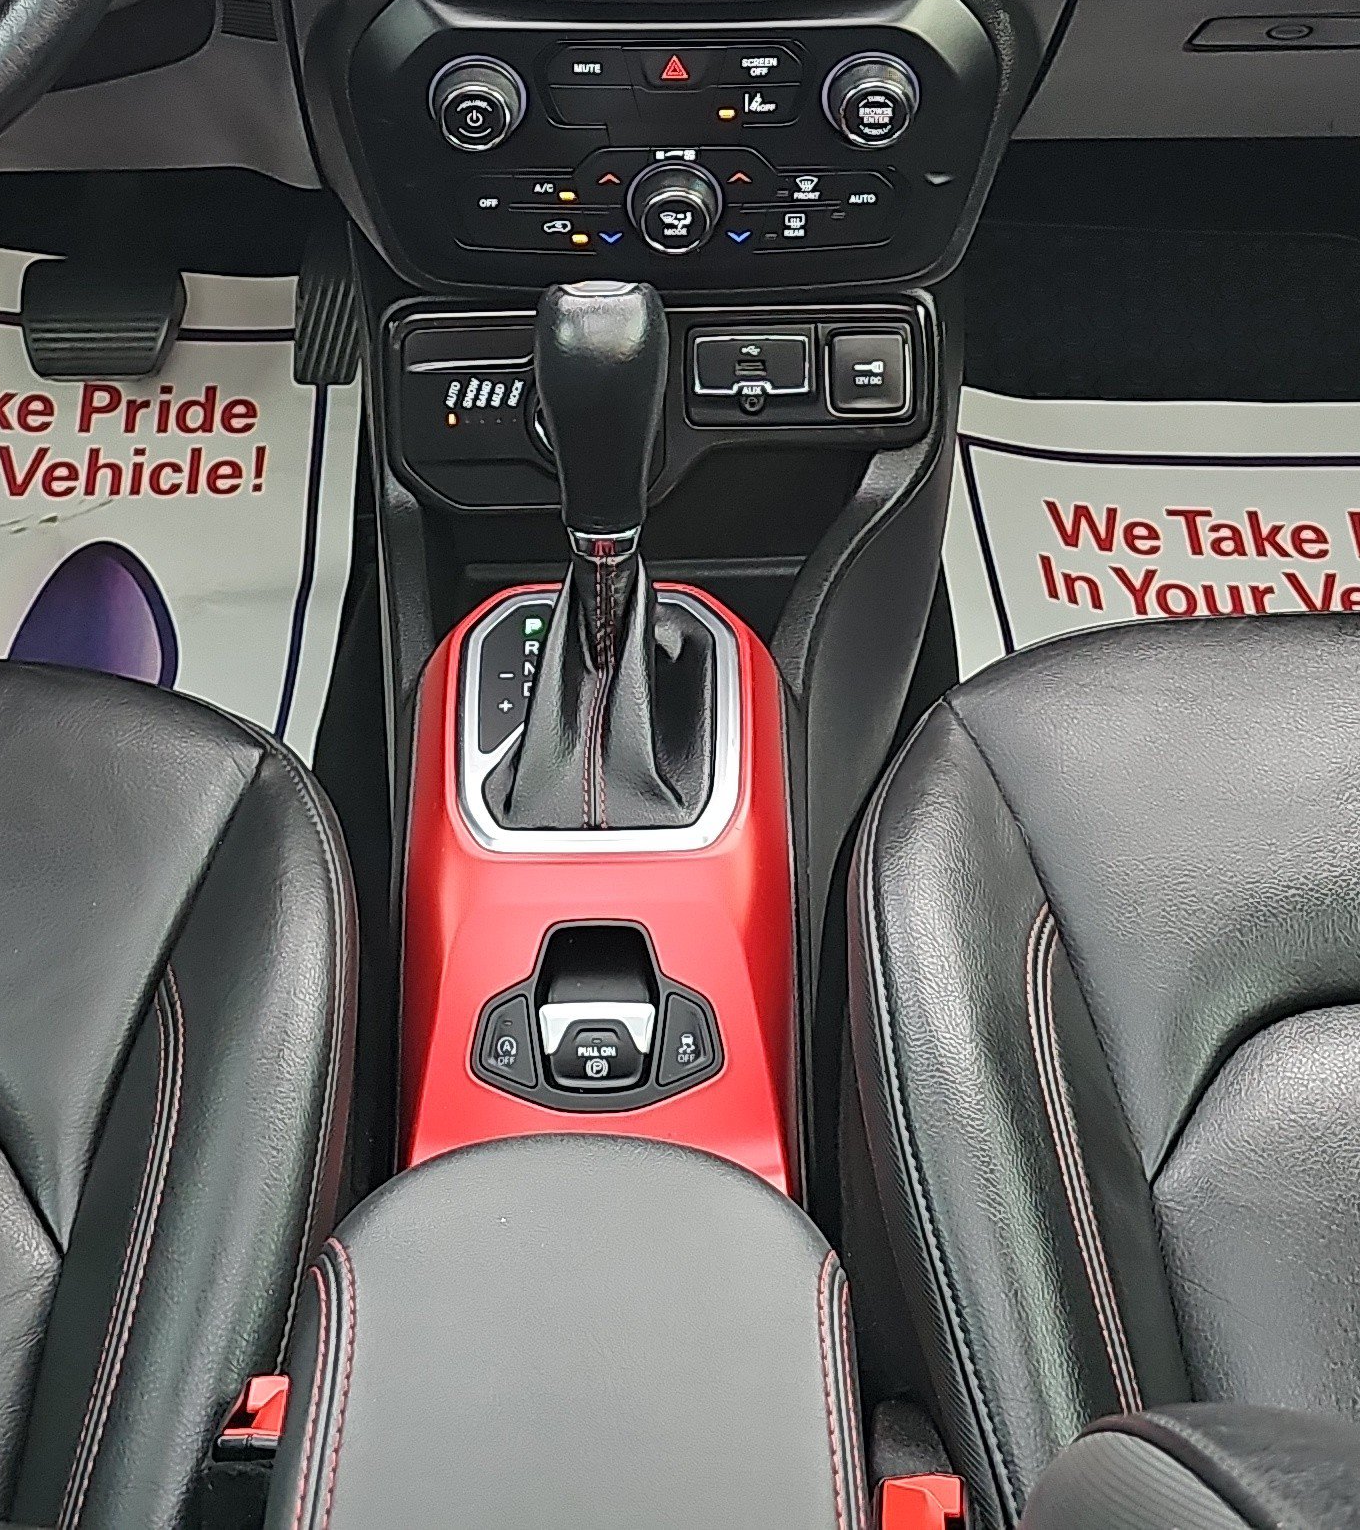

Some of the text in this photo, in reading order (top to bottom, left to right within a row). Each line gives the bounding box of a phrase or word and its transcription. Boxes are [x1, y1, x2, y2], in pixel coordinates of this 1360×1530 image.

[742, 58, 778, 67] SCREEN
[573, 63, 601, 74] MUTE
[750, 67, 768, 76] OFF
[859, 107, 893, 116] BROWSE
[863, 116, 889, 124] ENTER
[534, 183, 554, 193] A/C
[793, 192, 820, 200] FRONT
[849, 194, 876, 204] AUTO
[479, 199, 499, 208] OFF
[664, 228, 688, 236] MODE
[783, 229, 805, 237] REAR
[445, 381, 460, 408] AUTO
[462, 377, 480, 408] SNOW
[476, 380, 492, 408] SAND
[490, 383, 505, 408] MUD
[507, 379, 525, 407] ROCK
[741, 386, 762, 395] AUX
[77, 381, 260, 436] Pride
[1042, 498, 1162, 557] We
[1165, 508, 1331, 560] Take
[1039, 553, 1105, 611] In
[1109, 565, 1276, 616] Your
[525, 618, 543, 635] P
[525, 640, 540, 656] R
[577, 1047, 617, 1057] PULL ON
[498, 1057, 516, 1066] OFF
[677, 1054, 696, 1063] OFF
